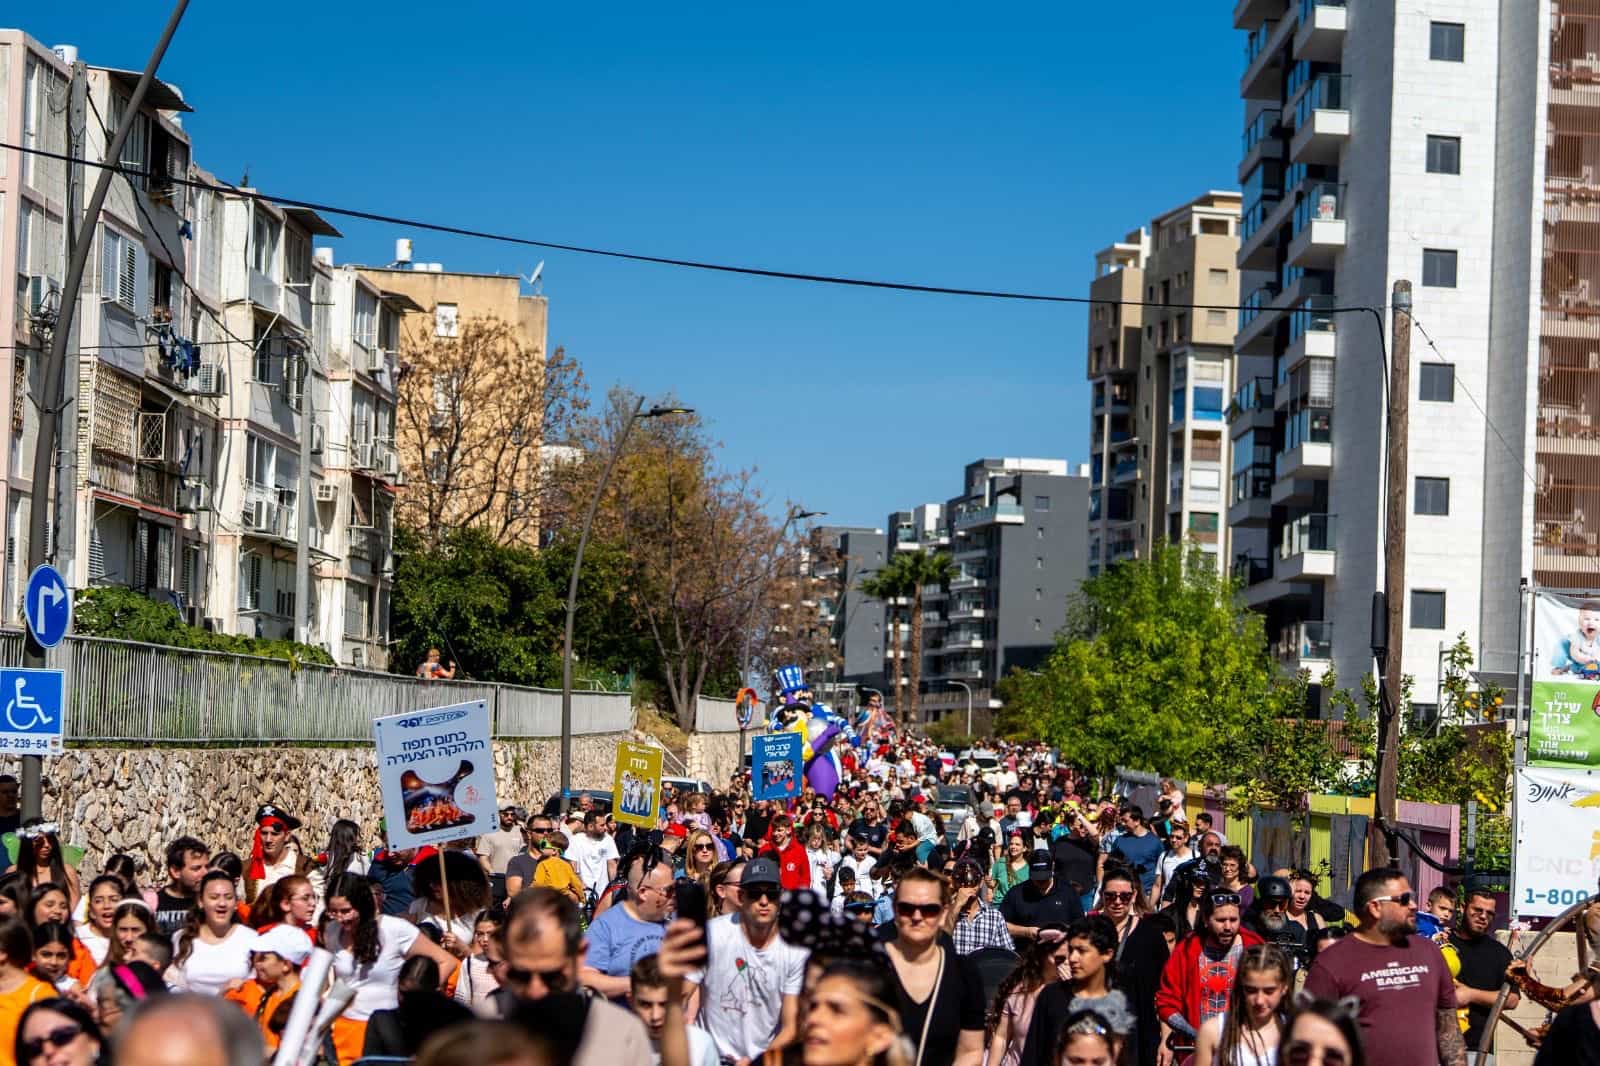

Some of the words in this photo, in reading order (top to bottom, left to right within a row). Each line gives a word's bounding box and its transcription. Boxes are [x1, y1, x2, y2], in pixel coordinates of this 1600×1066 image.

[1544, 698, 1581, 714] שילד
[1538, 712, 1571, 727] צריך
[402, 737, 431, 751] תפוז
[433, 731, 467, 746] כתום
[1537, 740, 1558, 749] אחד
[438, 739, 484, 757] הלהקה
[386, 748, 435, 766] הצעירה
[1528, 781, 1576, 803] אמונה
[1360, 965, 1429, 982] AMERICAN
[1376, 974, 1420, 986] EAGLE
